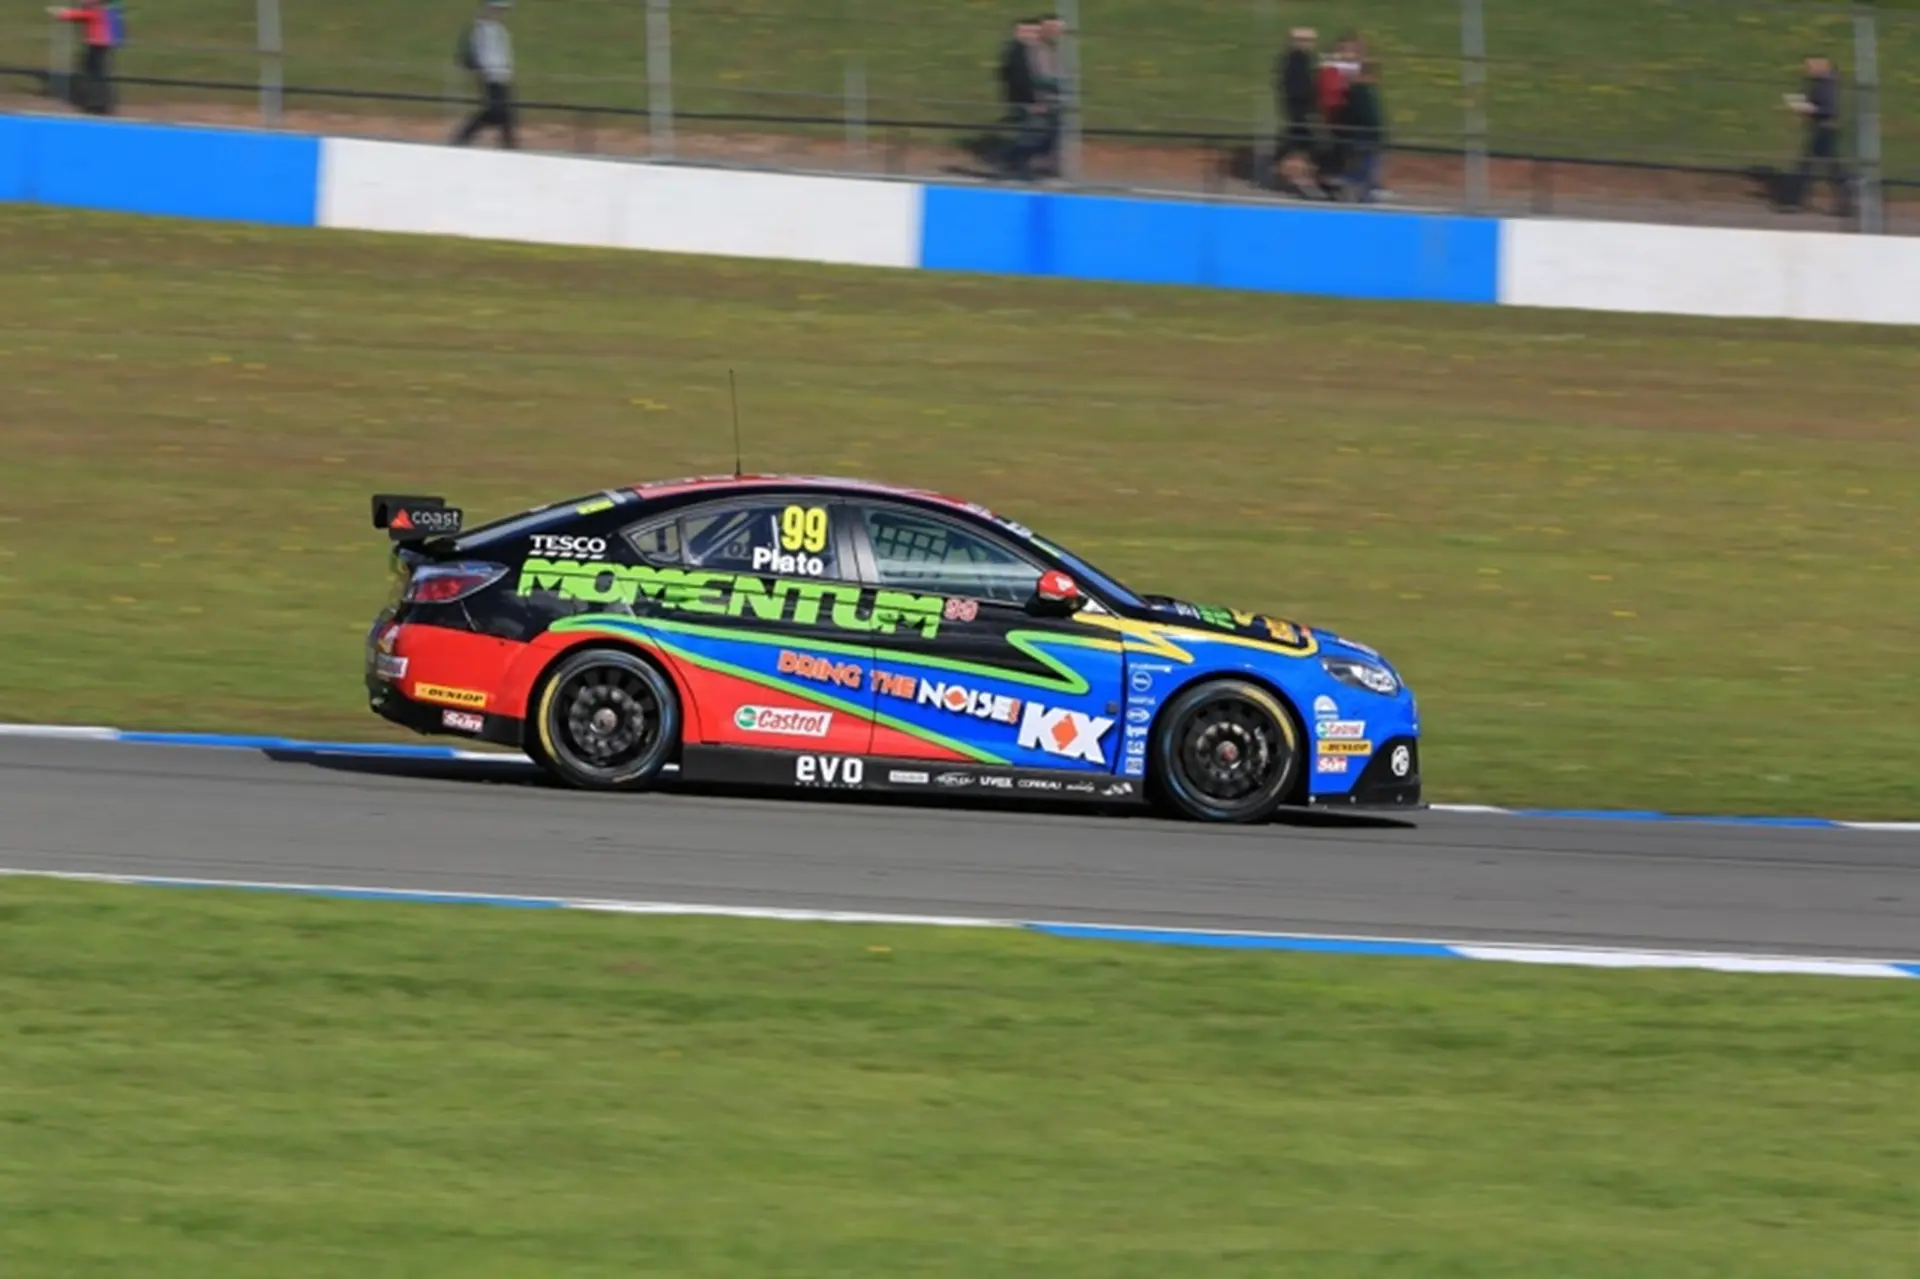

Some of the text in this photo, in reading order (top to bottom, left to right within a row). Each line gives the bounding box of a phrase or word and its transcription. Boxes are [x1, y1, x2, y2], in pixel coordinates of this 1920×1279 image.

[412, 510, 459, 526] coast
[782, 505, 827, 552] 99
[529, 535, 607, 553] TESCO
[752, 546, 824, 575] Plato
[516, 558, 944, 639] MOMENTUM
[777, 650, 862, 688] BRING
[870, 669, 917, 699] THE
[428, 687, 484, 703] DUNLOP
[758, 709, 825, 734] Castrol
[796, 754, 863, 784] evo
